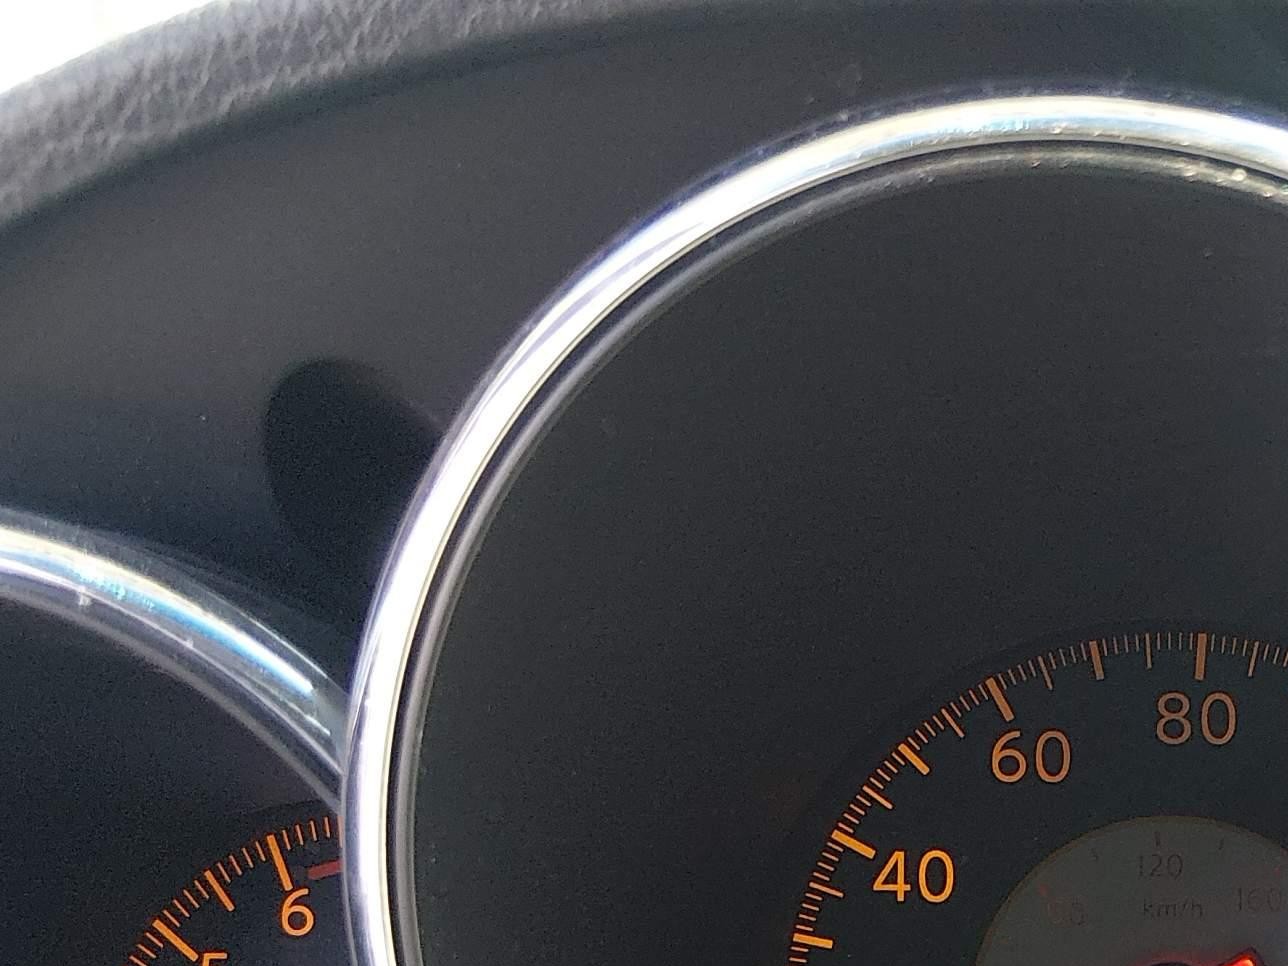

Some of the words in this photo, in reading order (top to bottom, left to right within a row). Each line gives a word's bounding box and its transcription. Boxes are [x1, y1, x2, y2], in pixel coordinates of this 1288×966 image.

[1155, 692, 1236, 745] 80
[991, 730, 1071, 783] 60
[872, 848, 955, 904] 40
[1136, 854, 1183, 878] 120
[281, 886, 314, 937] 6
